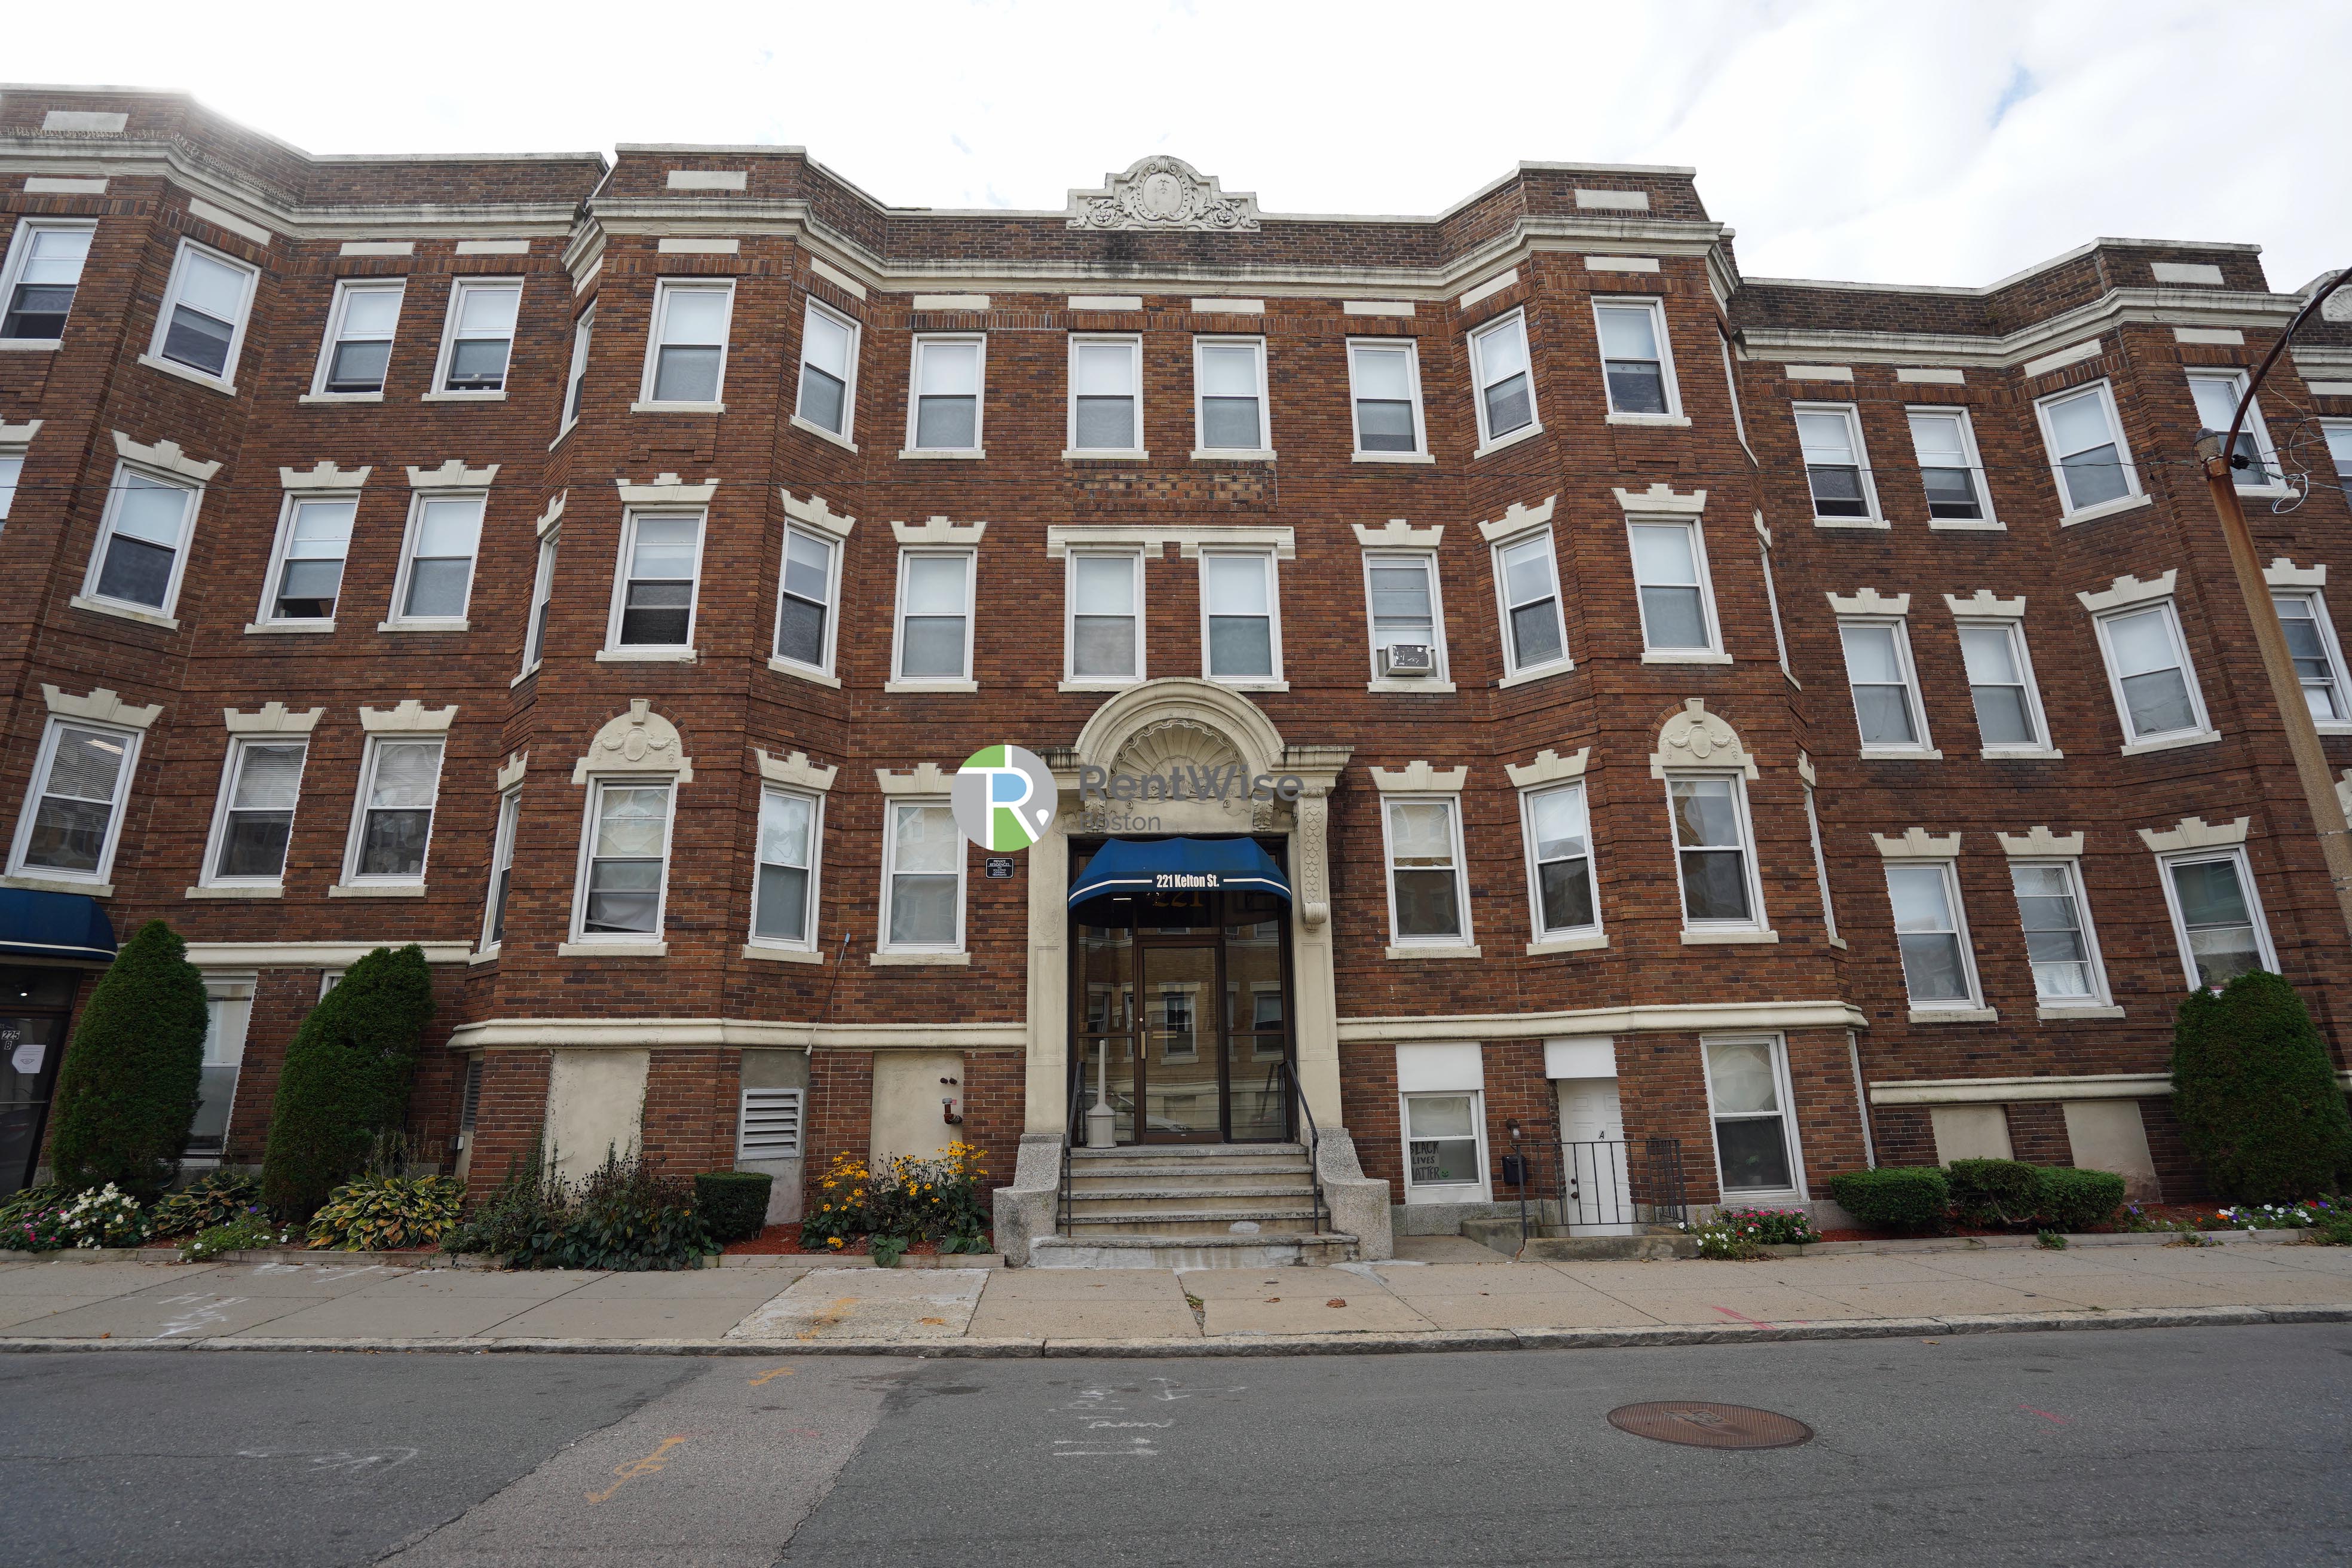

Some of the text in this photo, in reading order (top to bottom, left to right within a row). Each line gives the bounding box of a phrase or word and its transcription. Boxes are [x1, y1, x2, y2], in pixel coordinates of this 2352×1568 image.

[1156, 874, 1220, 888] 221 Kelton St.
[1598, 1131, 1604, 1139] A
[1412, 1156, 1435, 1165] LIVES
